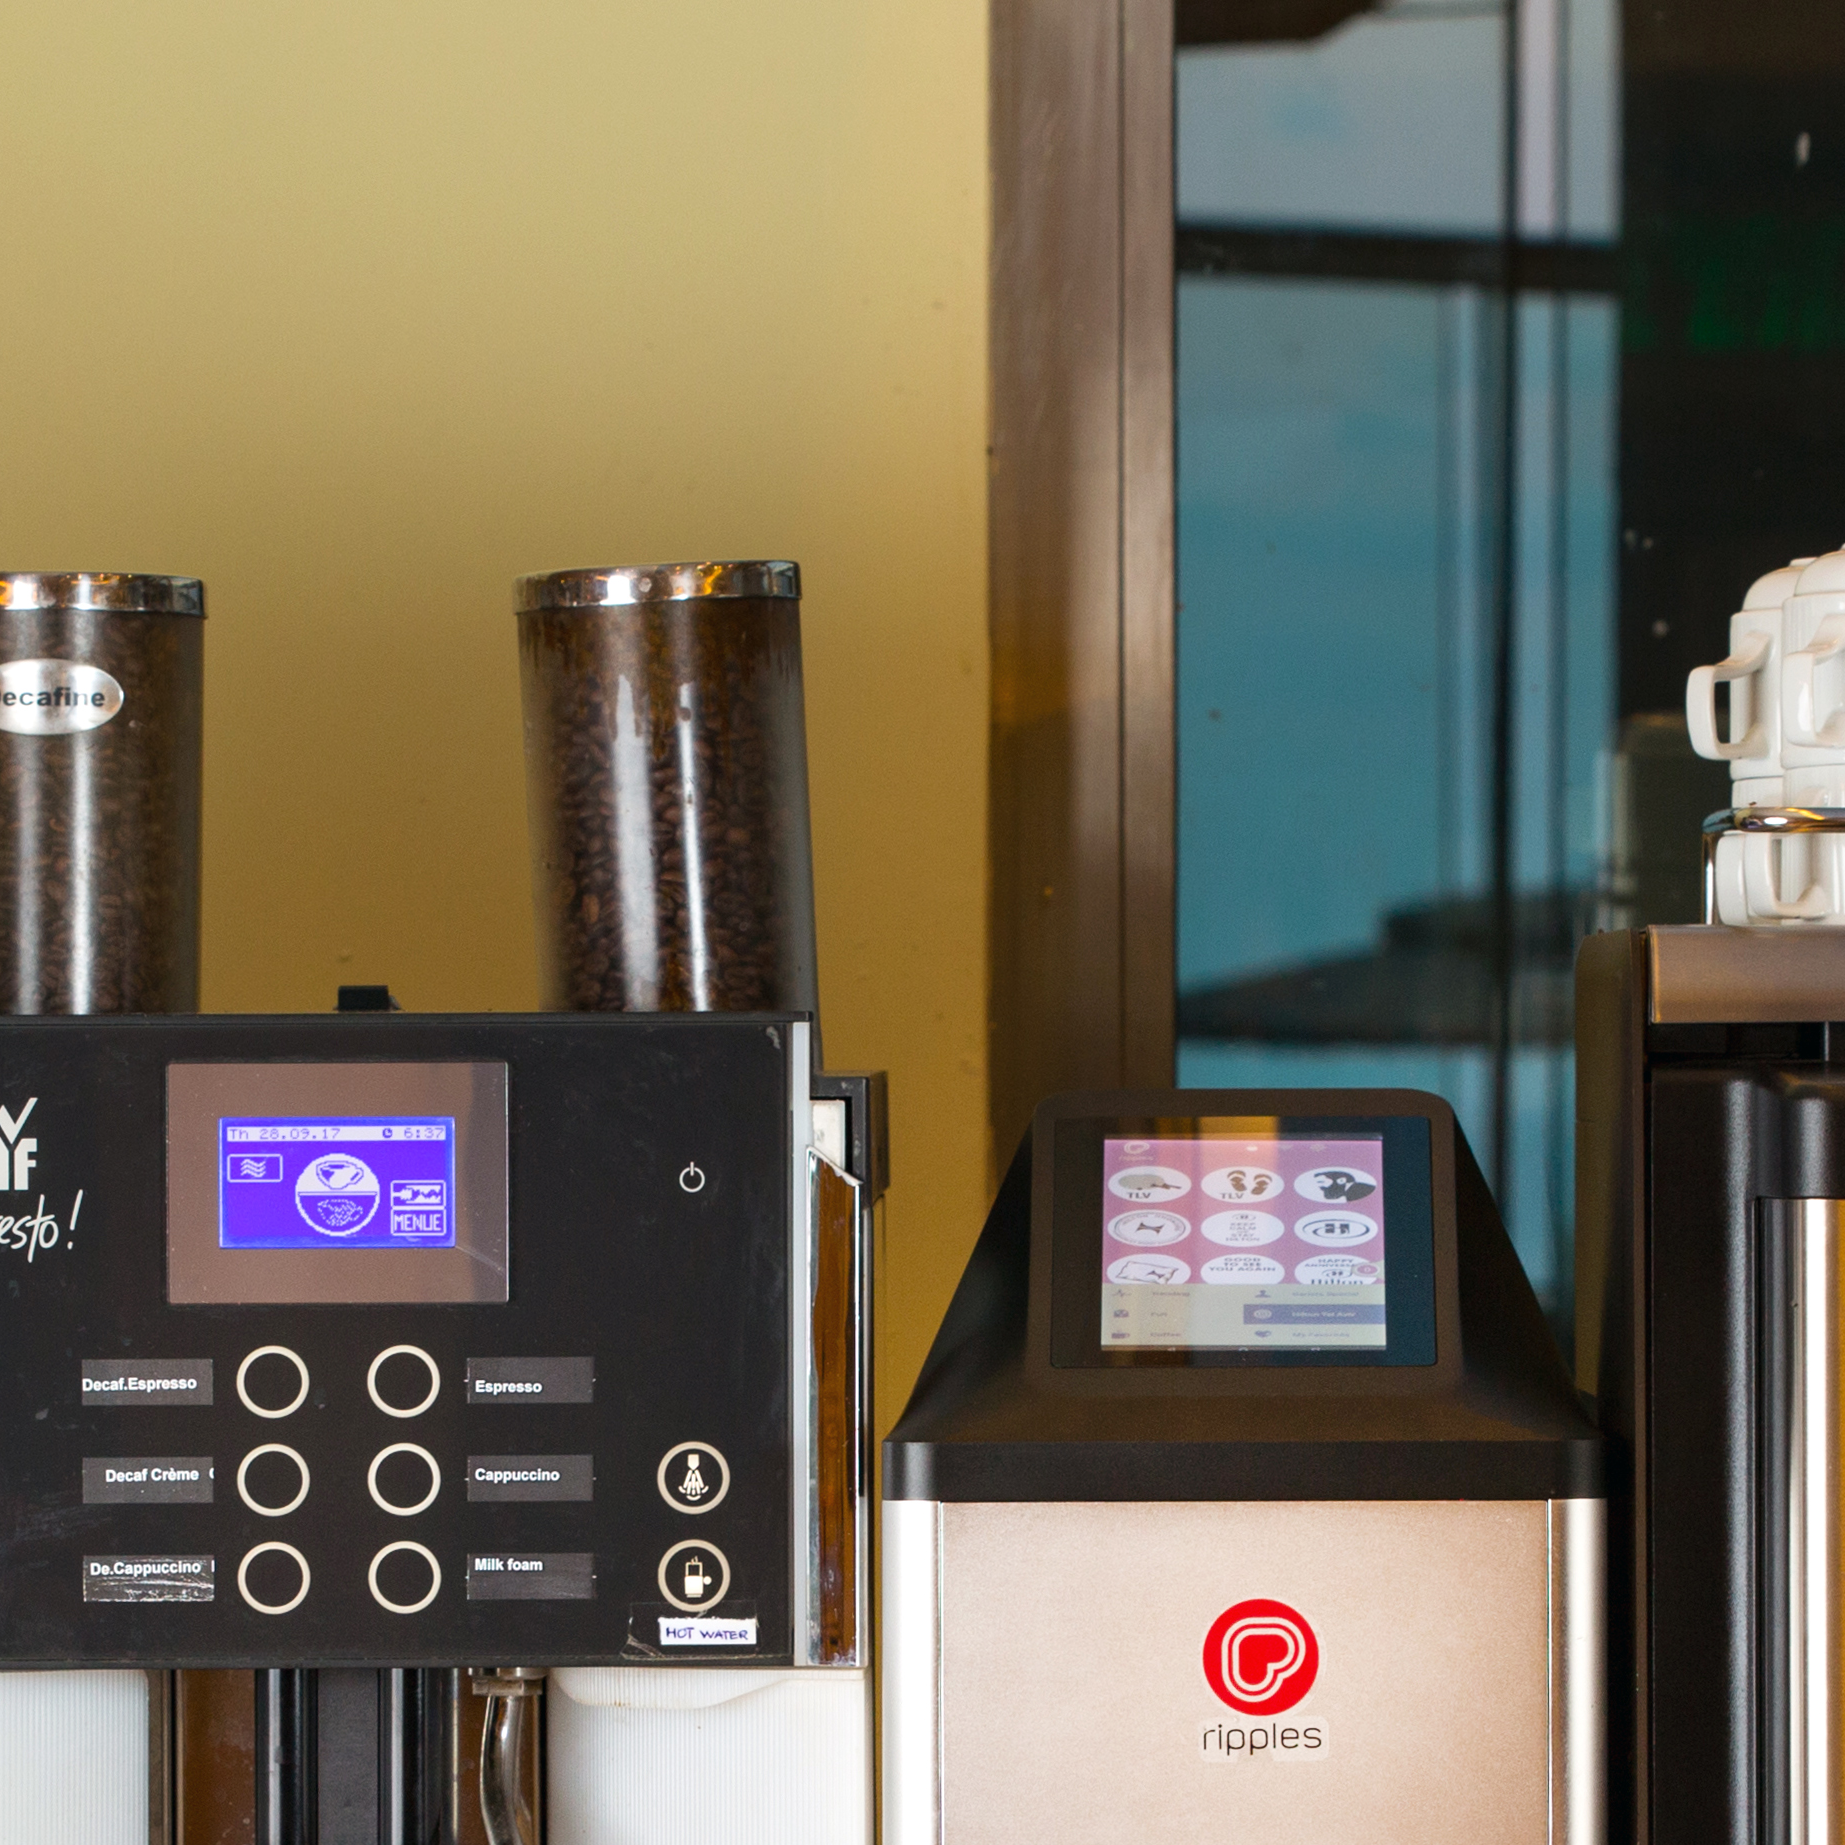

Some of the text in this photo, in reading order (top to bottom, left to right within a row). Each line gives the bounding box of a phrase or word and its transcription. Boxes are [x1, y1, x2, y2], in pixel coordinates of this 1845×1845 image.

[229, 1127, 444, 1139] Th 28.09.17 6:37
[394, 1213, 442, 1231] MENUE
[82, 1377, 198, 1393] Decaf.Espresso
[475, 1379, 543, 1395] Espresso
[105, 1469, 148, 1482] Decaf
[151, 1467, 199, 1482] Crème
[474, 1468, 560, 1484] Cappuccino
[90, 1560, 201, 1577] De.Cappuccino
[474, 1558, 543, 1571] Milk foam
[666, 1627, 748, 1640] HOT WATER
[1203, 1722, 1322, 1756] ripples
